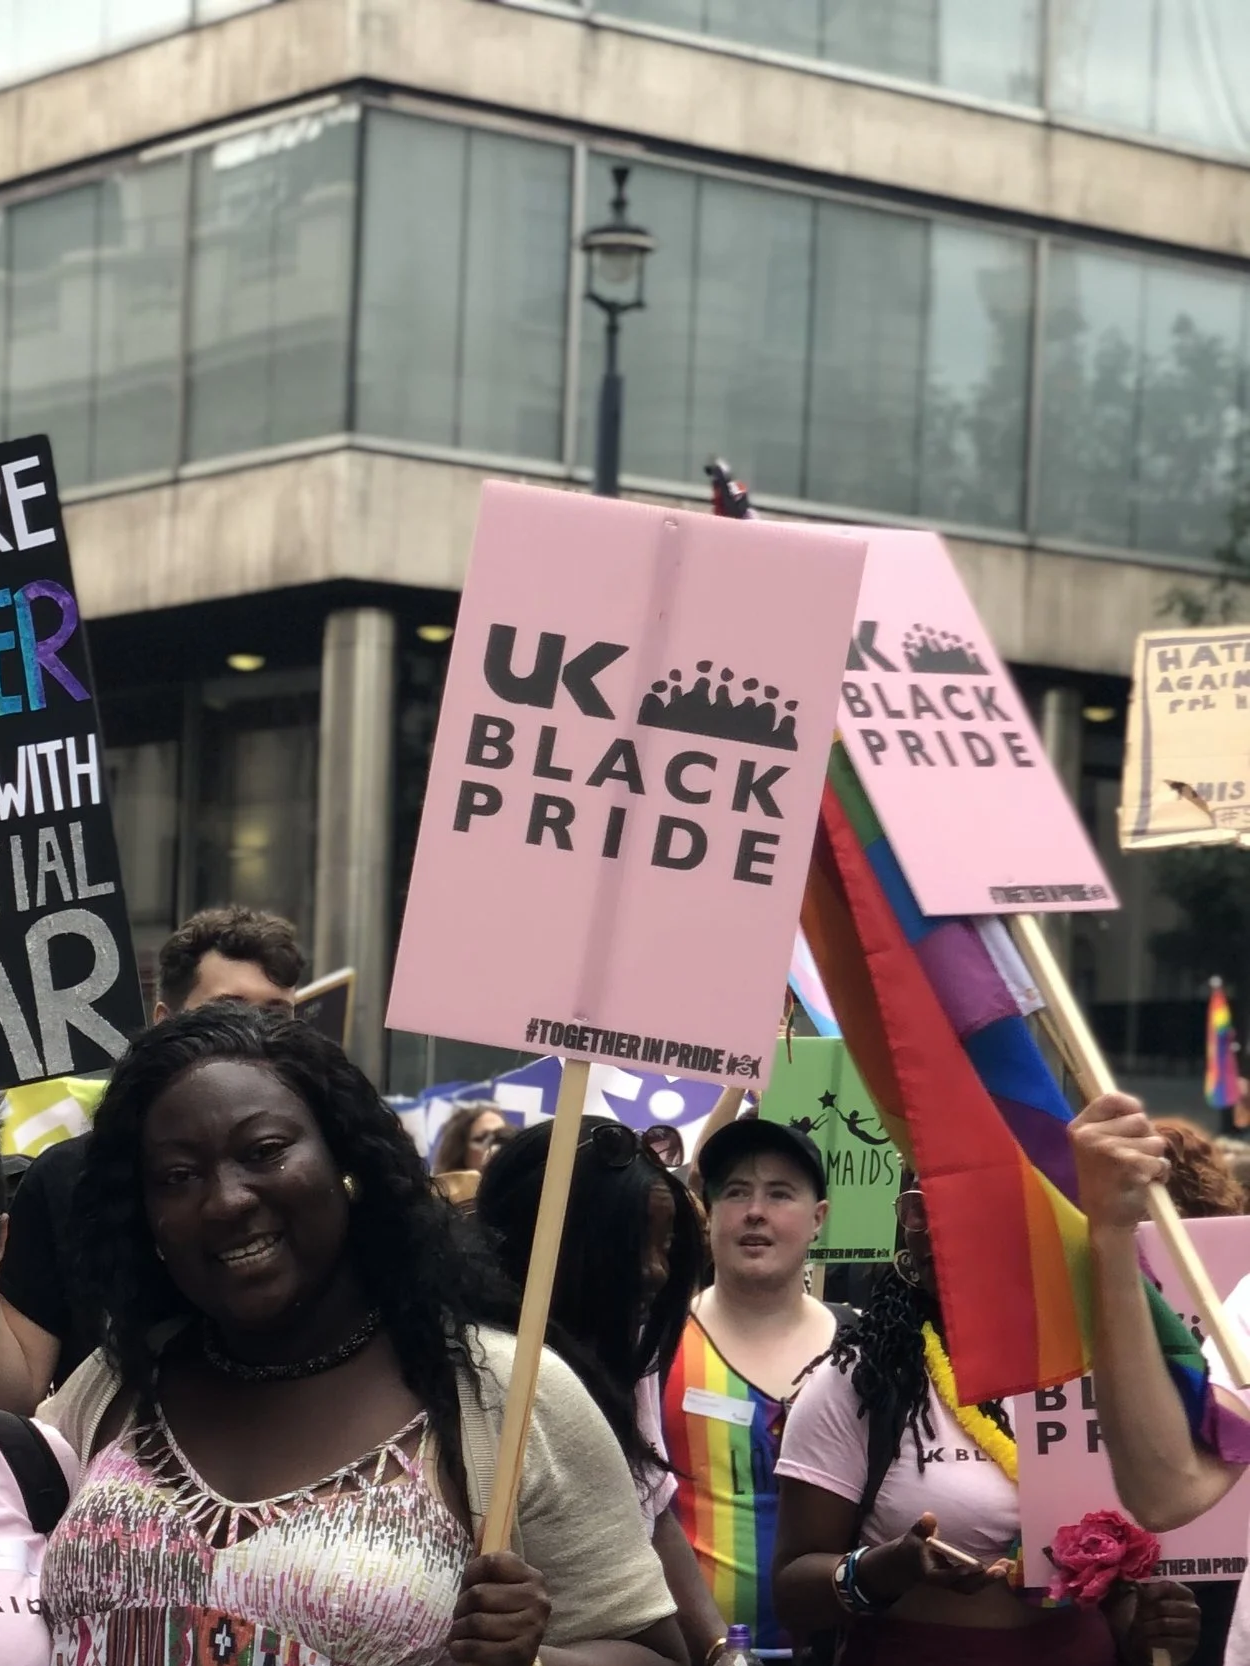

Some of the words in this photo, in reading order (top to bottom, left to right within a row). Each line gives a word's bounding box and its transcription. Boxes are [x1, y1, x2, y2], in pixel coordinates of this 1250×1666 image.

[484, 623, 630, 720] UK
[1157, 642, 1250, 672] HAT
[841, 682, 1014, 722] BLACK
[465, 713, 791, 819] BLACK
[857, 729, 1036, 768] PRIDE
[453, 780, 780, 886] PRIDE
[525, 1018, 641, 1060] #TOGETHER
[641, 1036, 664, 1064] IN
[664, 1040, 726, 1075] PRIDE
